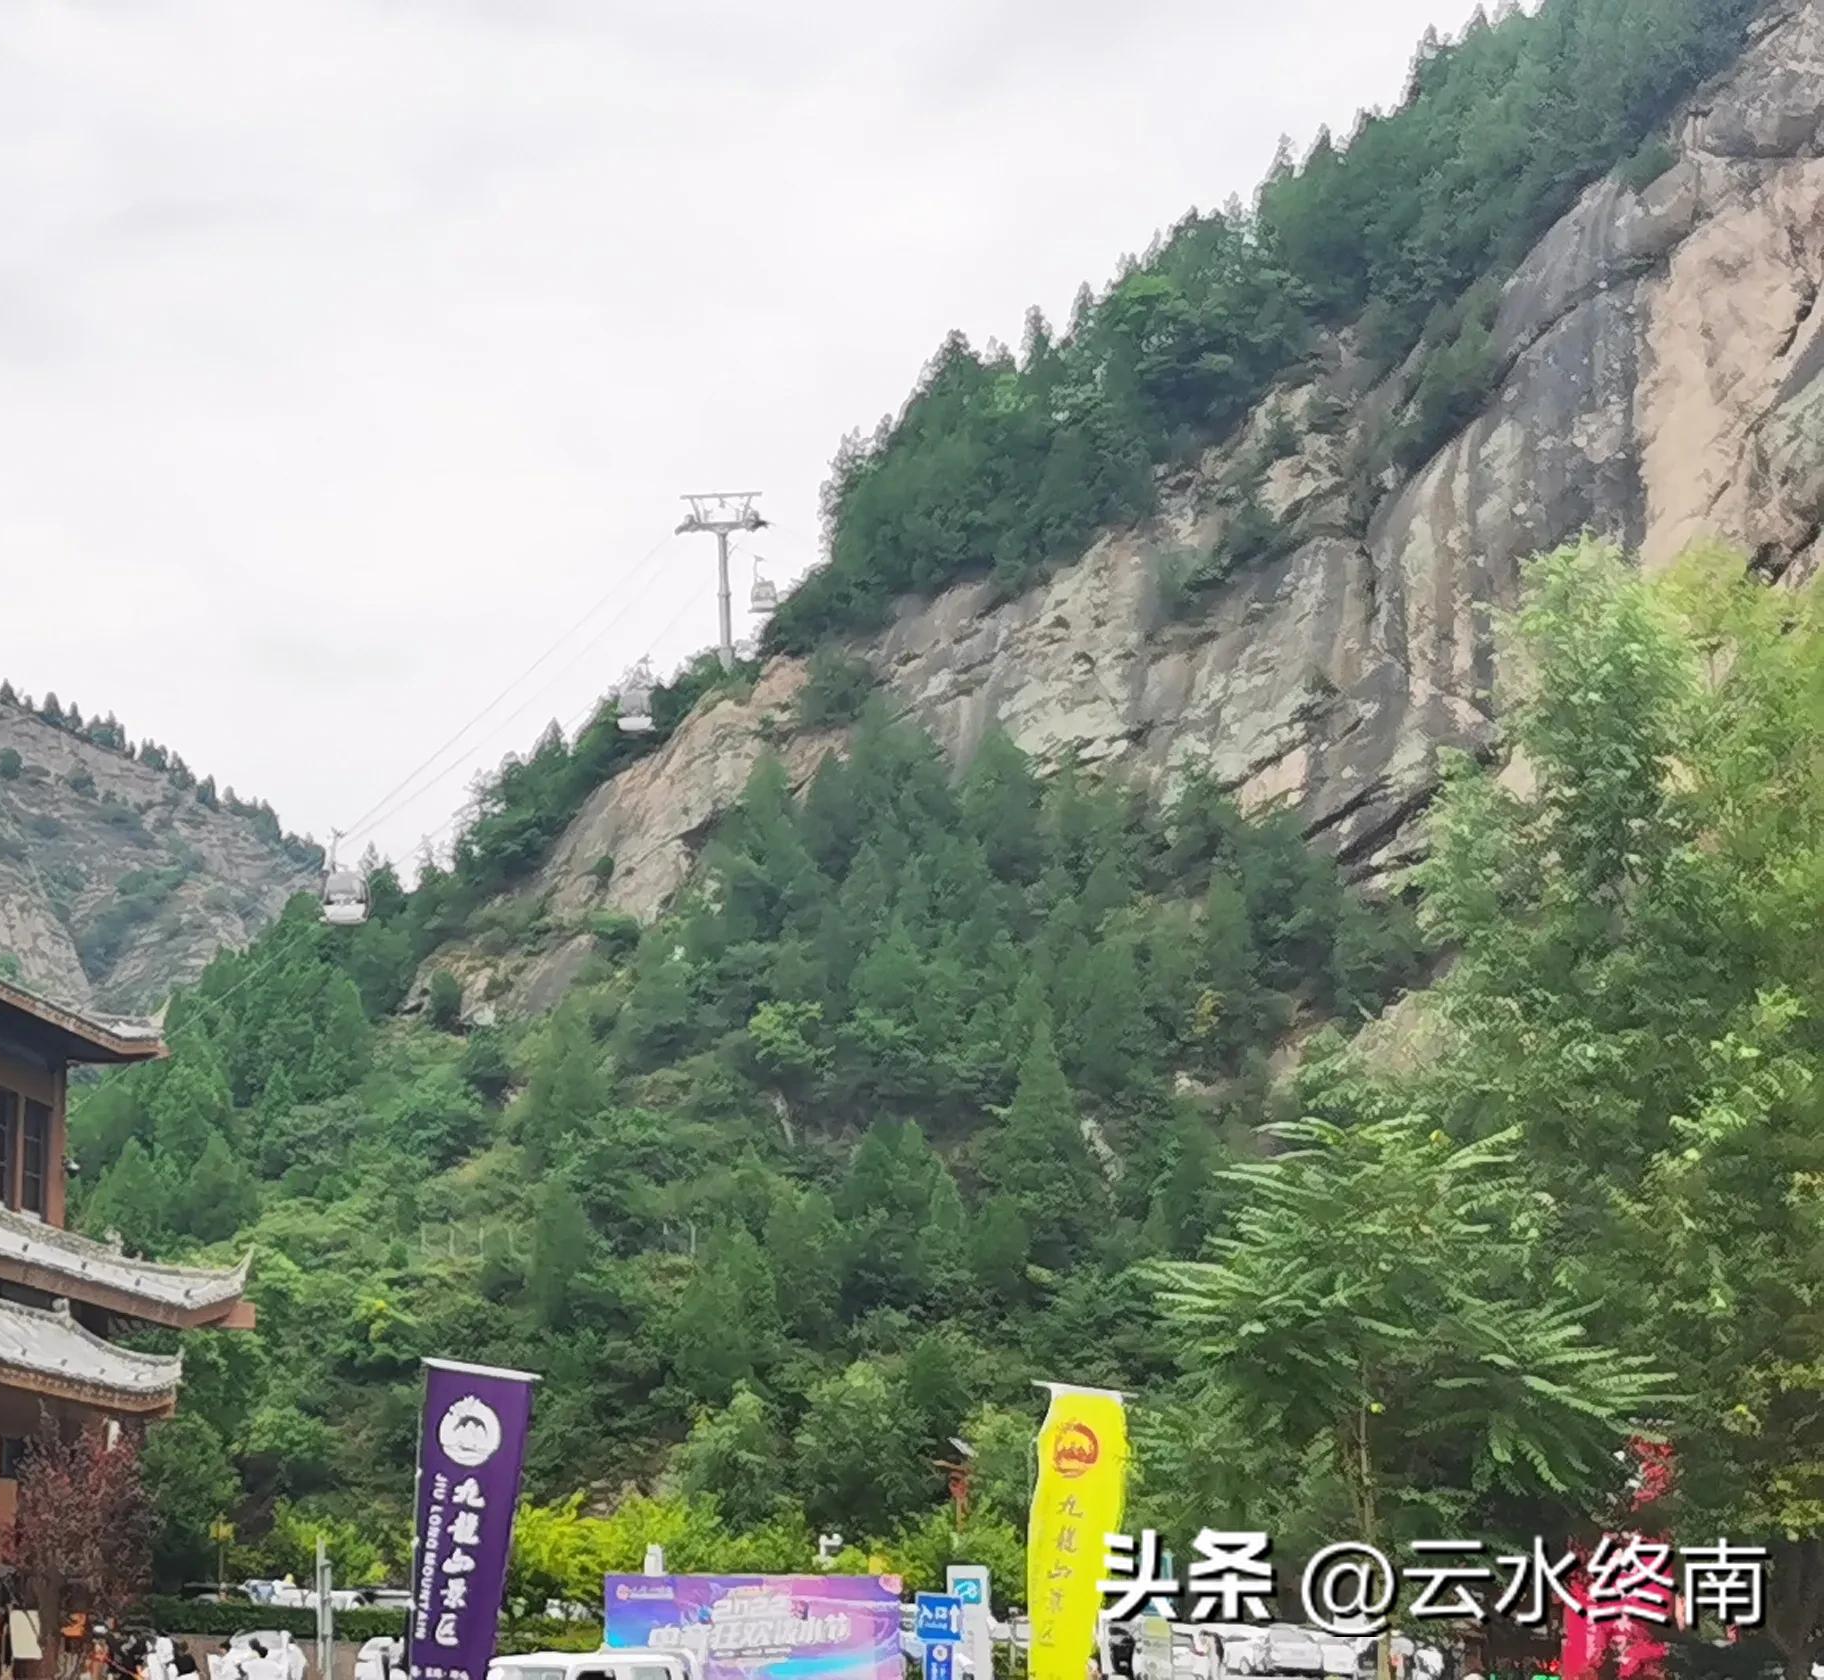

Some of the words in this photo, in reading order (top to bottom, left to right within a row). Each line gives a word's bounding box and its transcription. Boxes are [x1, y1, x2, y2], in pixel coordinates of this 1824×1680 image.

[432, 1473, 448, 1500] JIU
[425, 1505, 444, 1548] LONG
[415, 1550, 437, 1640] MOUNTAIN
[918, 1604, 948, 1629] 入口
